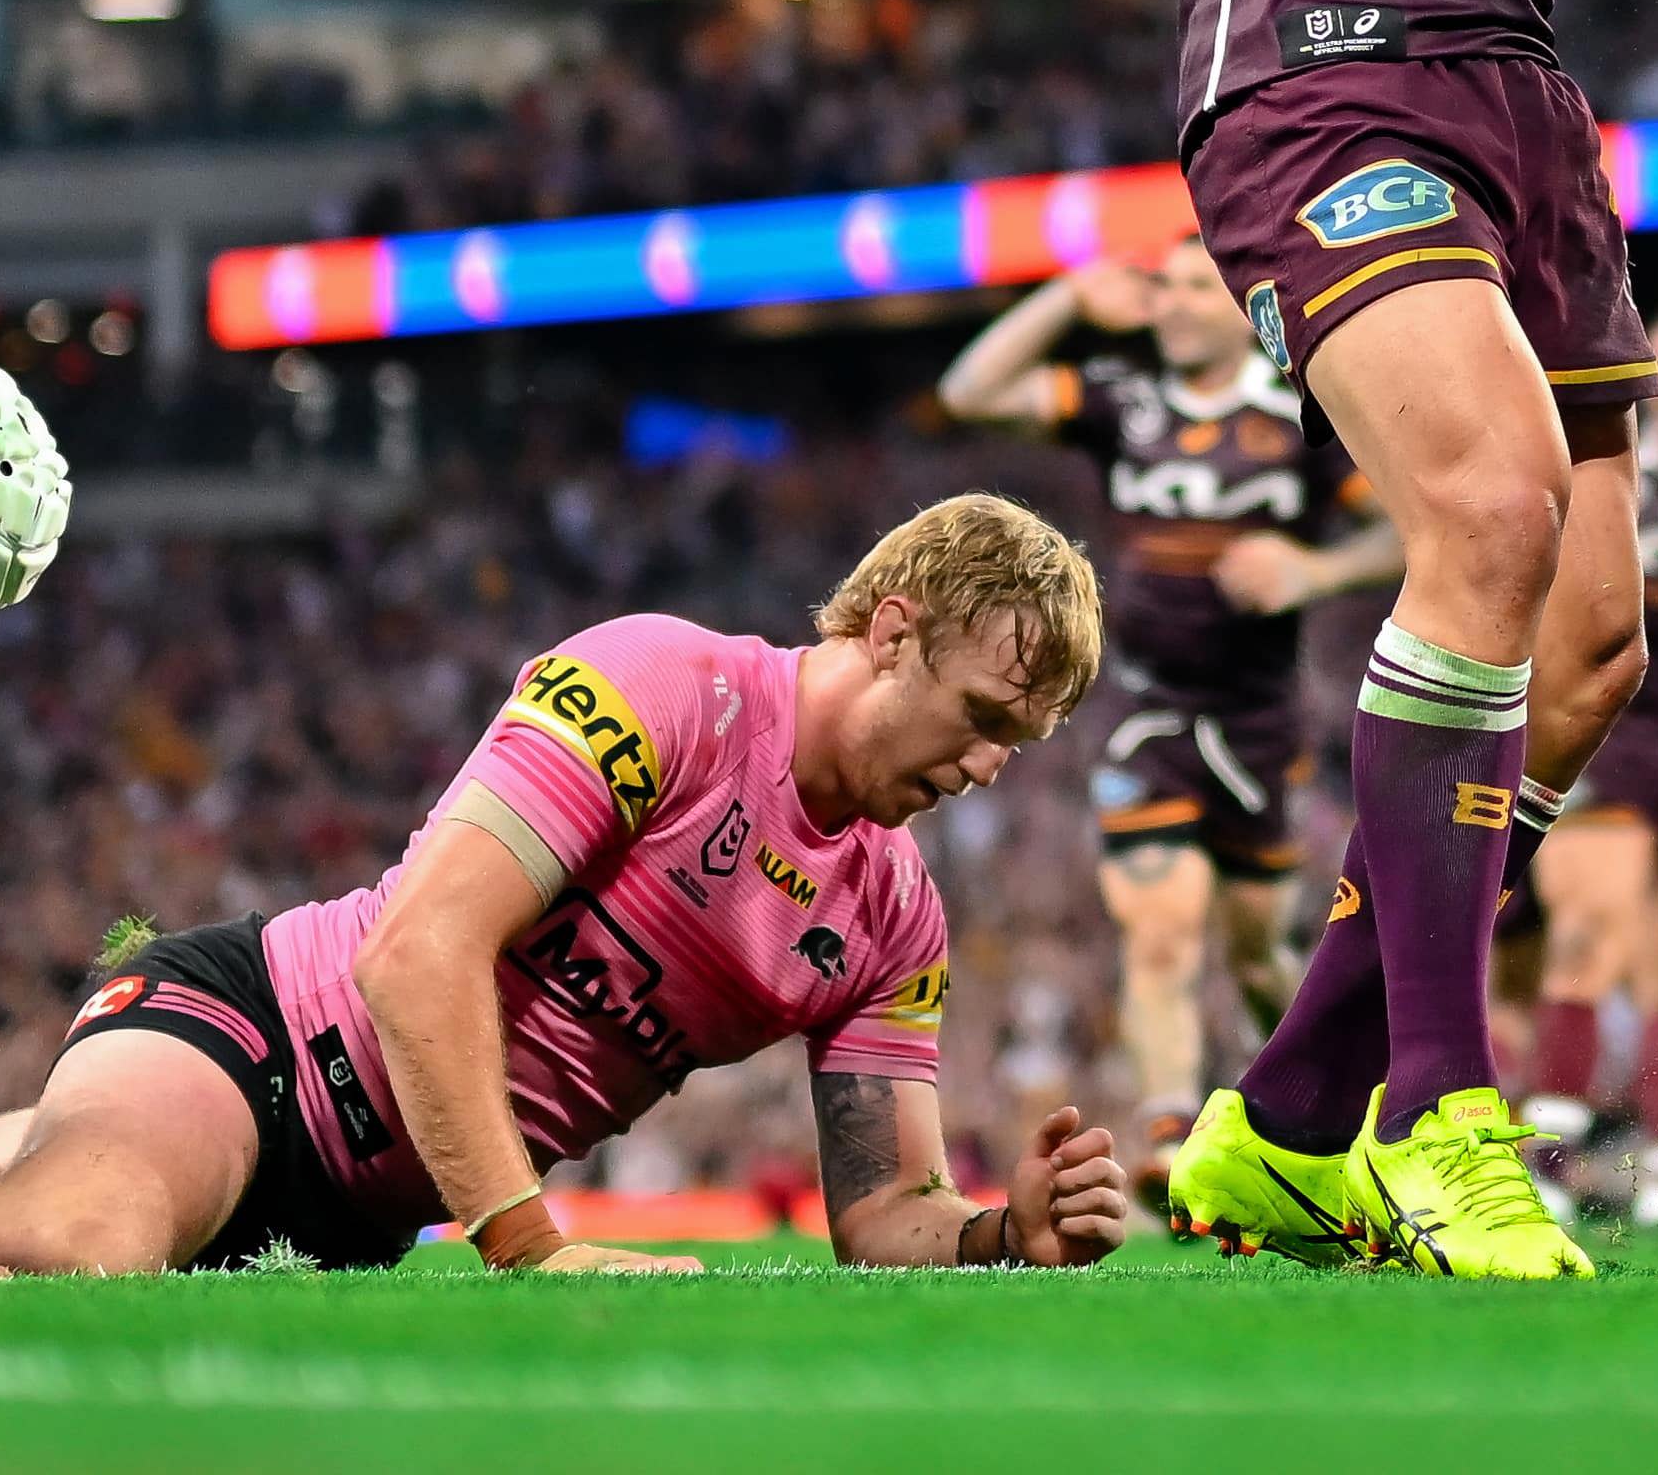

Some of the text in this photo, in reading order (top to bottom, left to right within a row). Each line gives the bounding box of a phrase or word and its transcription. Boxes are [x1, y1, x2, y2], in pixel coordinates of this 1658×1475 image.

[1331, 177, 1438, 233] BCF
[517, 657, 660, 808] Hertz
[755, 844, 819, 909] ALLAM
